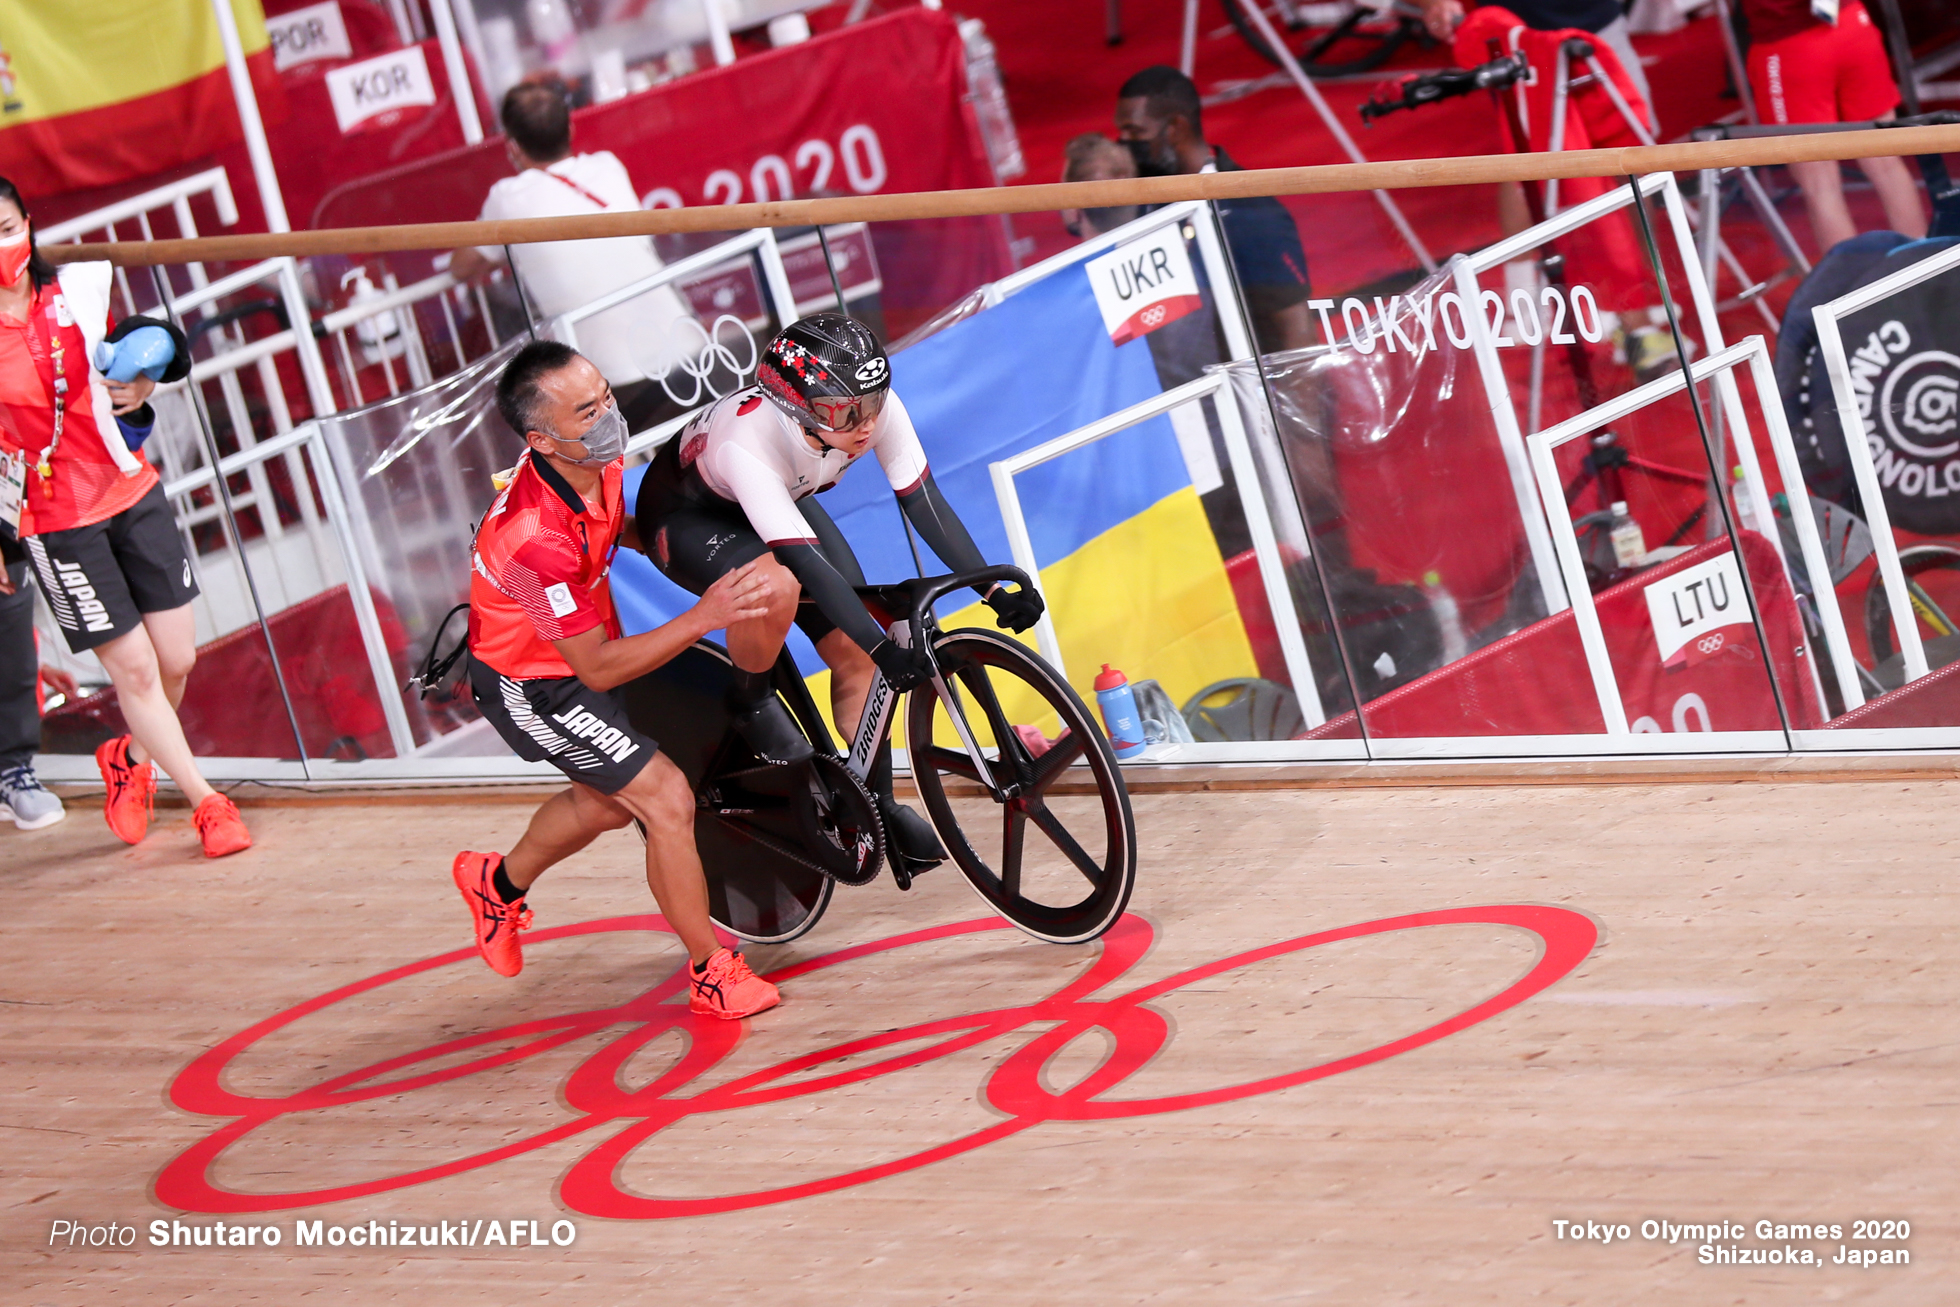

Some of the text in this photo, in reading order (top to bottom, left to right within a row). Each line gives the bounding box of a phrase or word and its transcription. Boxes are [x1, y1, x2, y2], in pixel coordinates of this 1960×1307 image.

[271, 17, 328, 54] POR
[350, 64, 413, 106] KOR
[1110, 247, 1175, 301] UKR
[1307, 285, 1603, 355] TOKYO 2020
[53, 558, 114, 632] JAPAN
[1672, 571, 1730, 628] LTU
[552, 704, 640, 764] JAPAN
